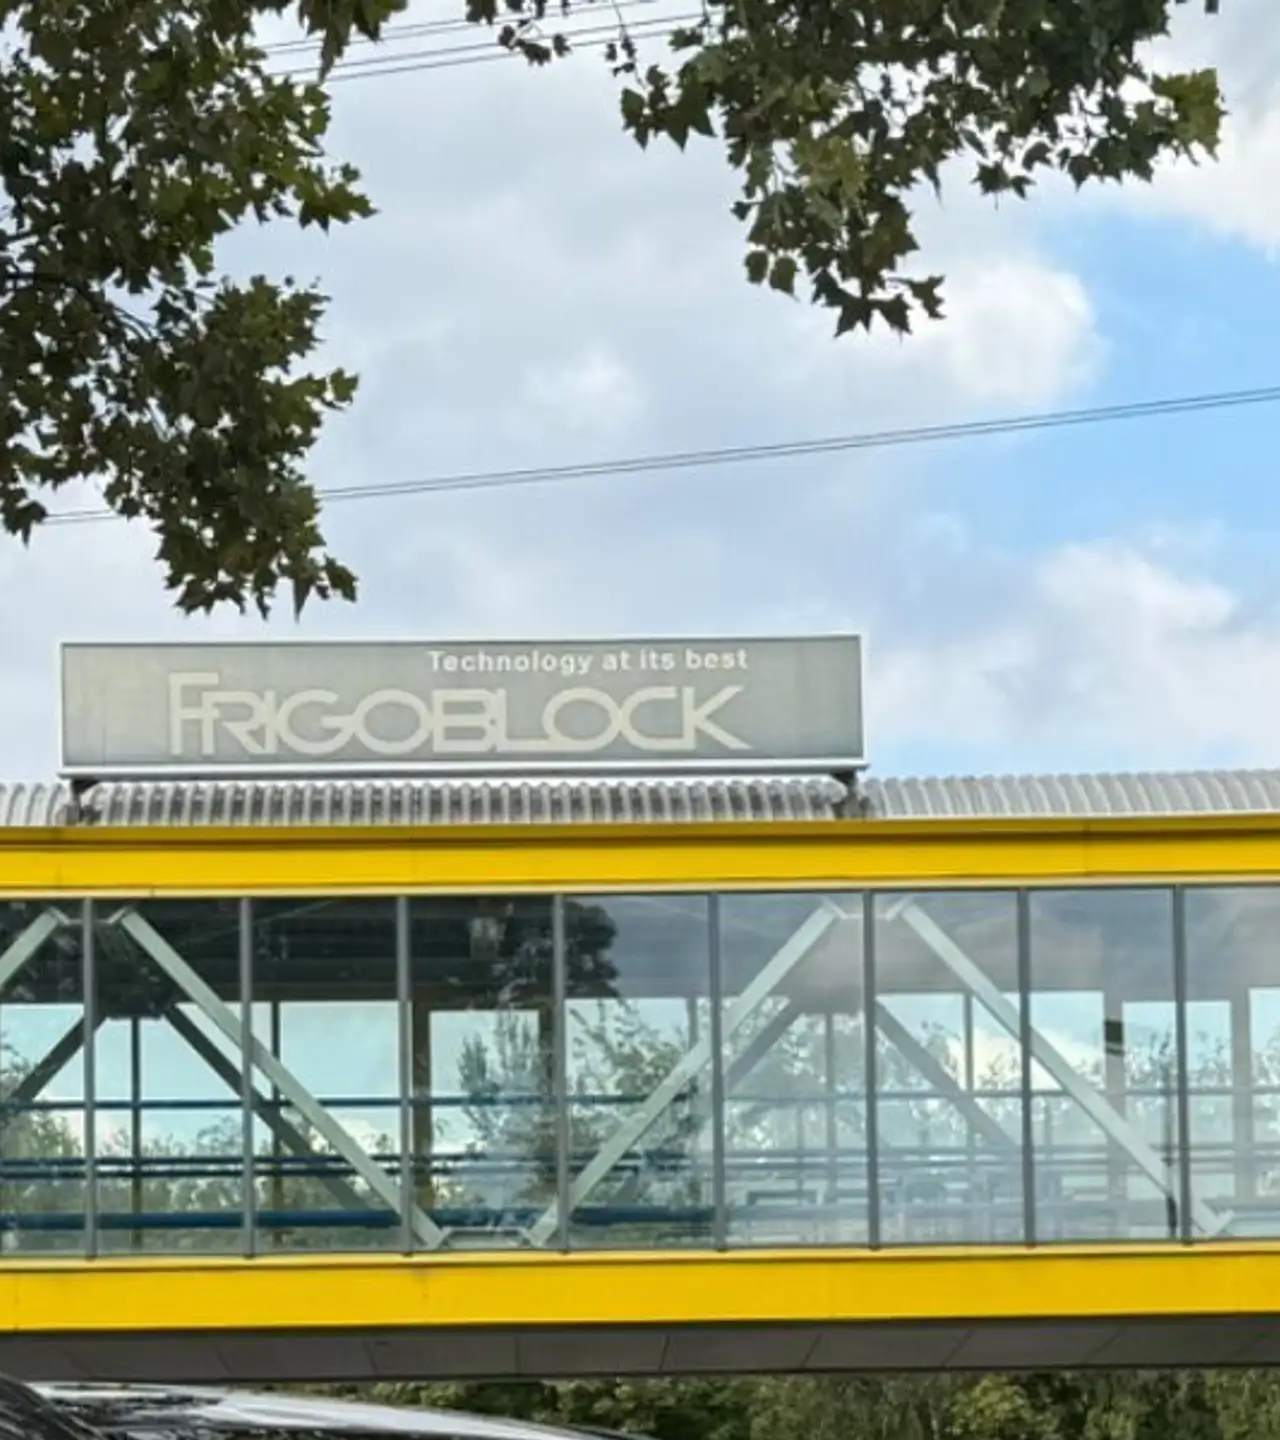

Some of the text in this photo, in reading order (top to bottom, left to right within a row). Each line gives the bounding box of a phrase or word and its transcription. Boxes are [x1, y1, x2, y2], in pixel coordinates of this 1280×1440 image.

[428, 648, 748, 676] Technology at its best
[168, 671, 752, 754] FRIGOBLOCK
